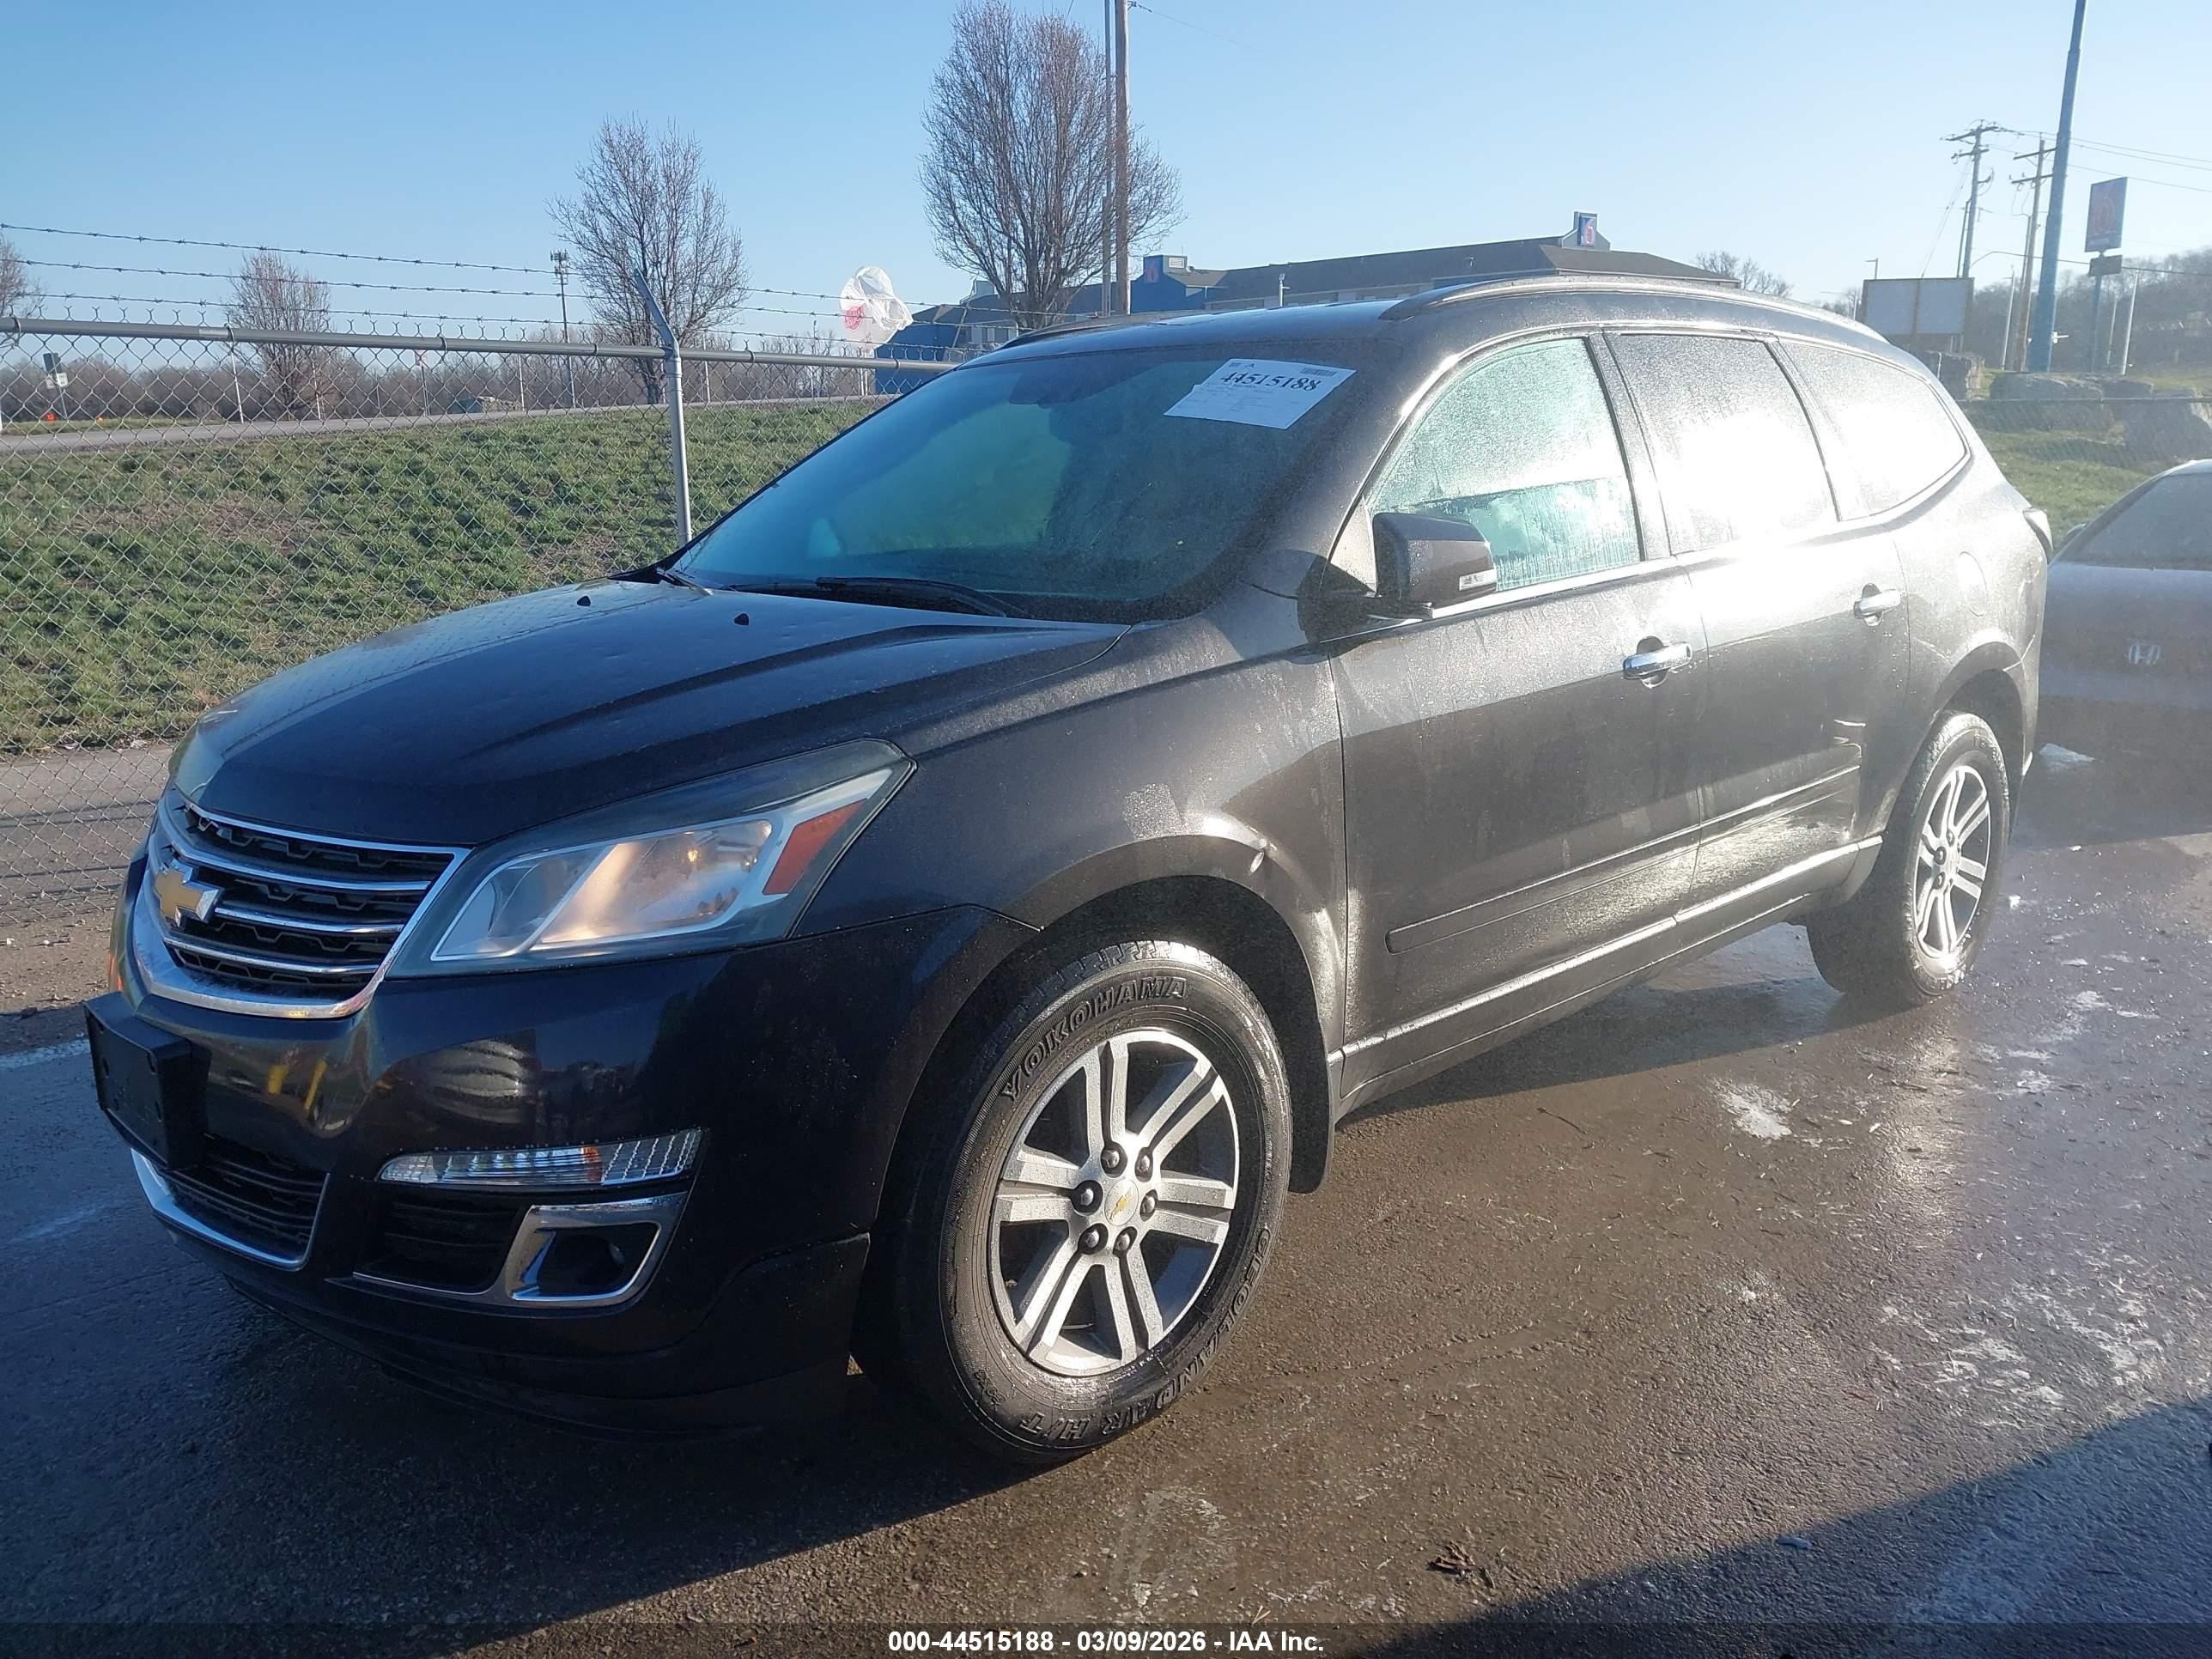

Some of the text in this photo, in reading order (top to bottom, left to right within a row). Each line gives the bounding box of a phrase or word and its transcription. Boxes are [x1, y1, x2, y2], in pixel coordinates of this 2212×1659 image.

[1219, 371, 1322, 392] 44515188
[1000, 975, 1188, 1103] YOKOHAMA
[1102, 1227, 1272, 1437] GEOLANDAR
